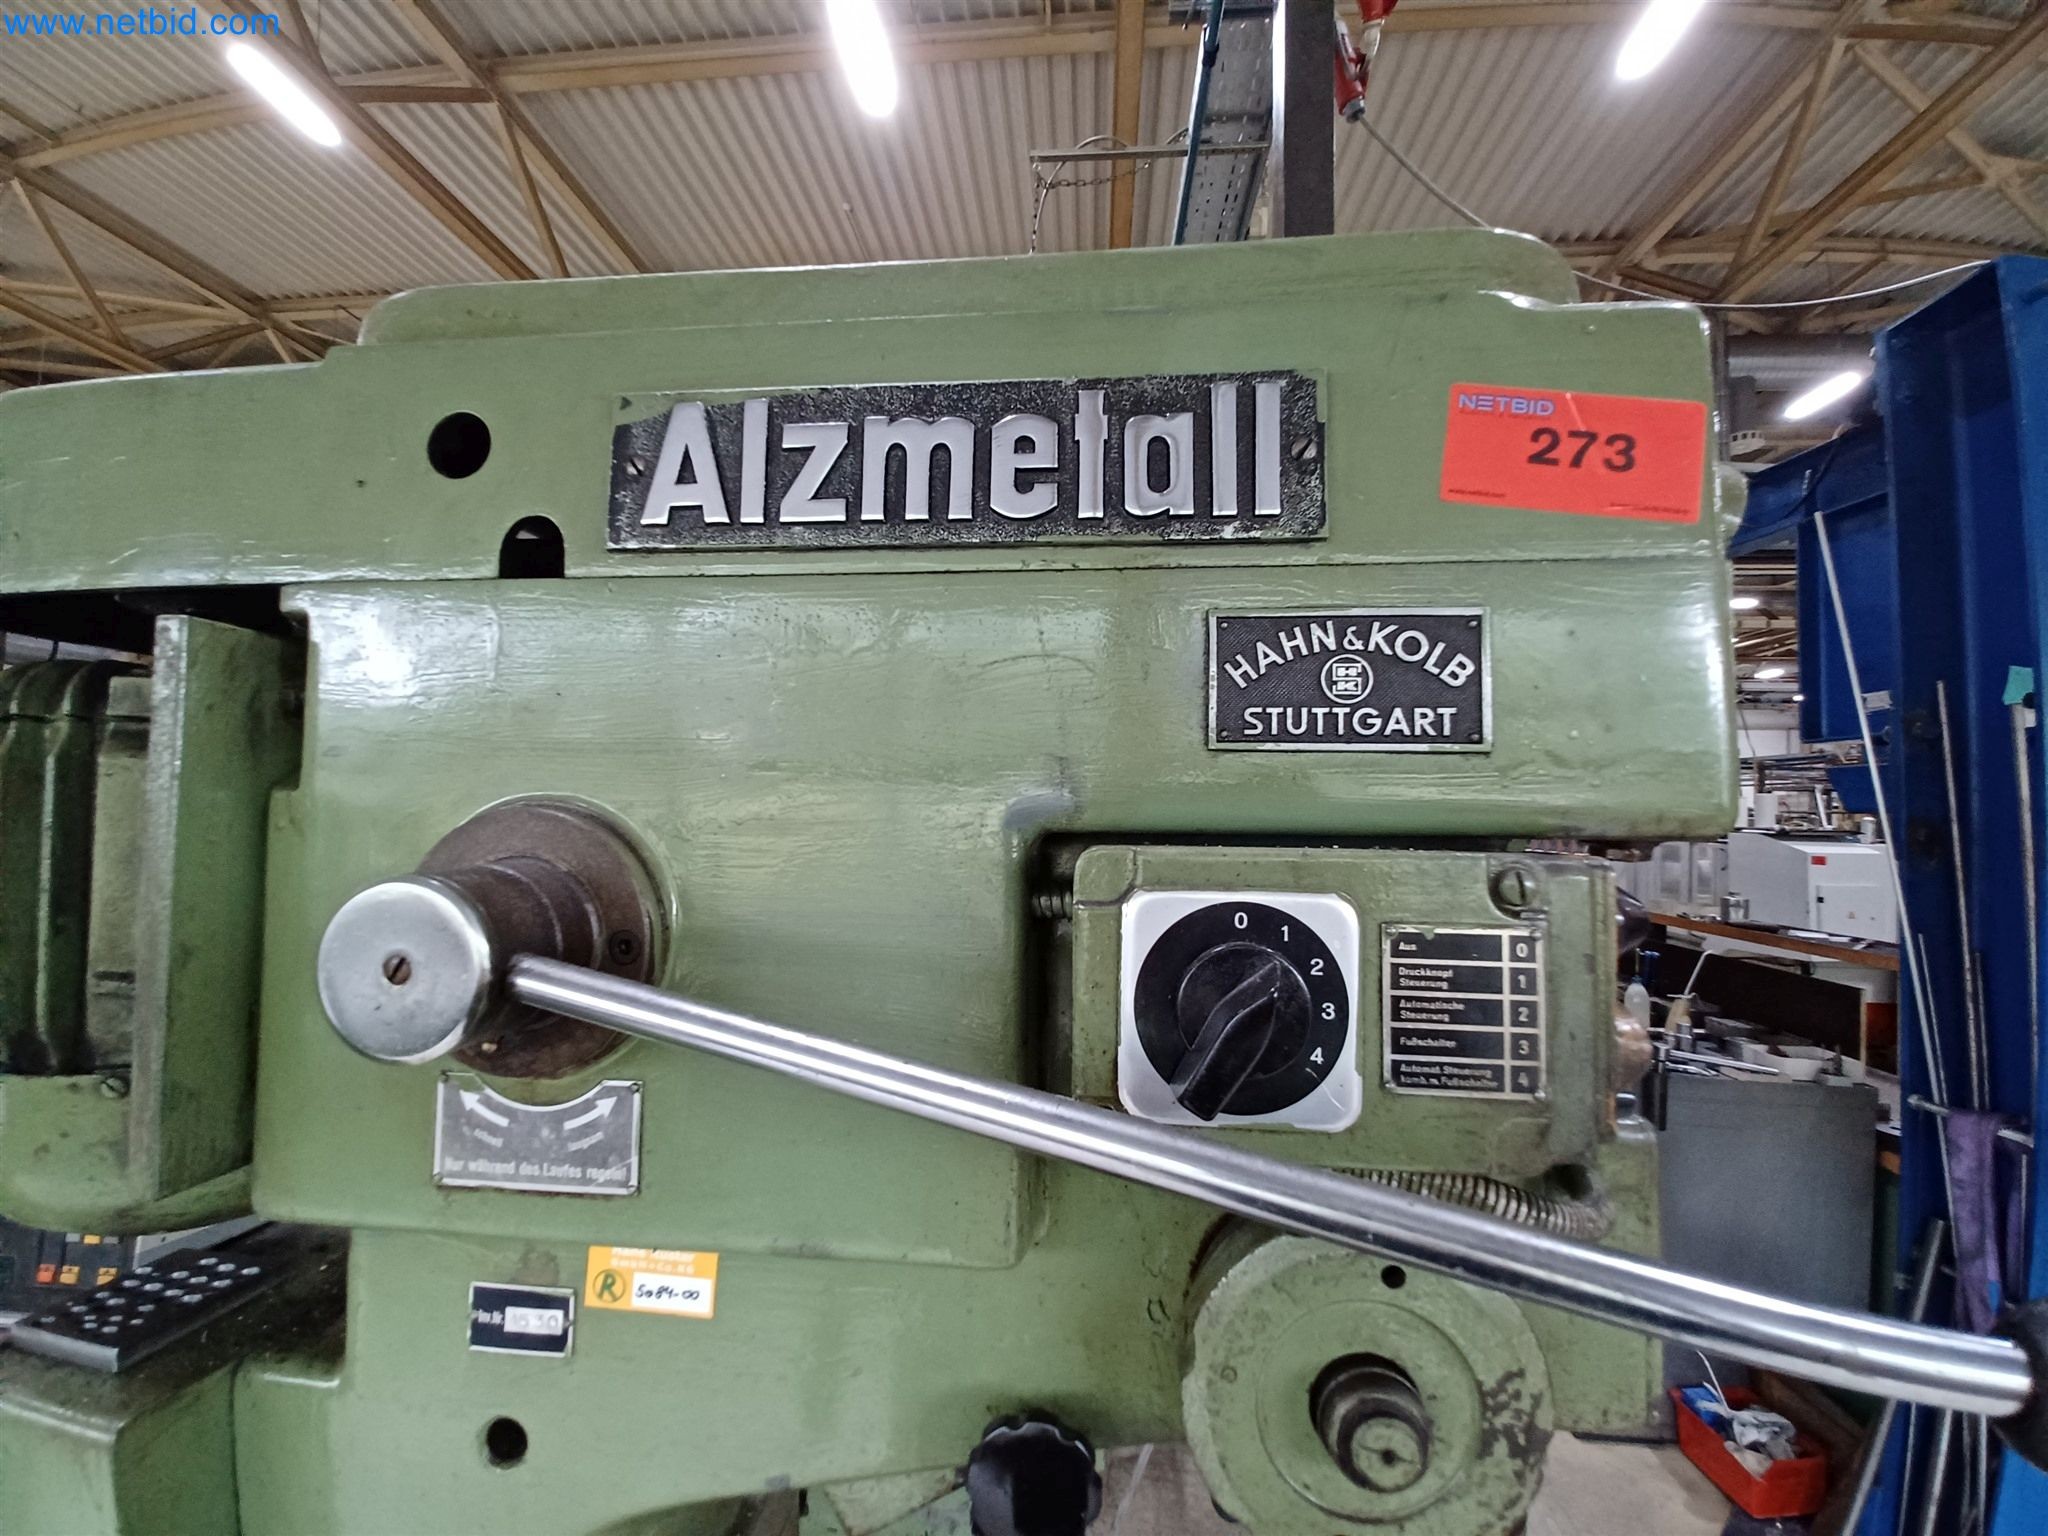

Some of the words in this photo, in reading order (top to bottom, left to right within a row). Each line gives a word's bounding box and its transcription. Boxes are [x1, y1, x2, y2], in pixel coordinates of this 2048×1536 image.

[1458, 394, 1555, 416] NETBID
[640, 382, 1287, 526] Alzmetall
[1527, 427, 1637, 472] 273
[1243, 707, 1458, 737] STUTTGART
[1234, 912, 1248, 929] 0
[1281, 925, 1289, 942] 1
[1515, 943, 1529, 957] 0
[1310, 959, 1324, 976] 2
[1517, 975, 1527, 989] 1
[1321, 1003, 1336, 1020] 3
[1517, 1007, 1529, 1022] 2
[1310, 1047, 1324, 1065] 4
[1519, 1040, 1530, 1055] 3
[1517, 1073, 1529, 1088] 4
[519, 1160, 540, 1176] des
